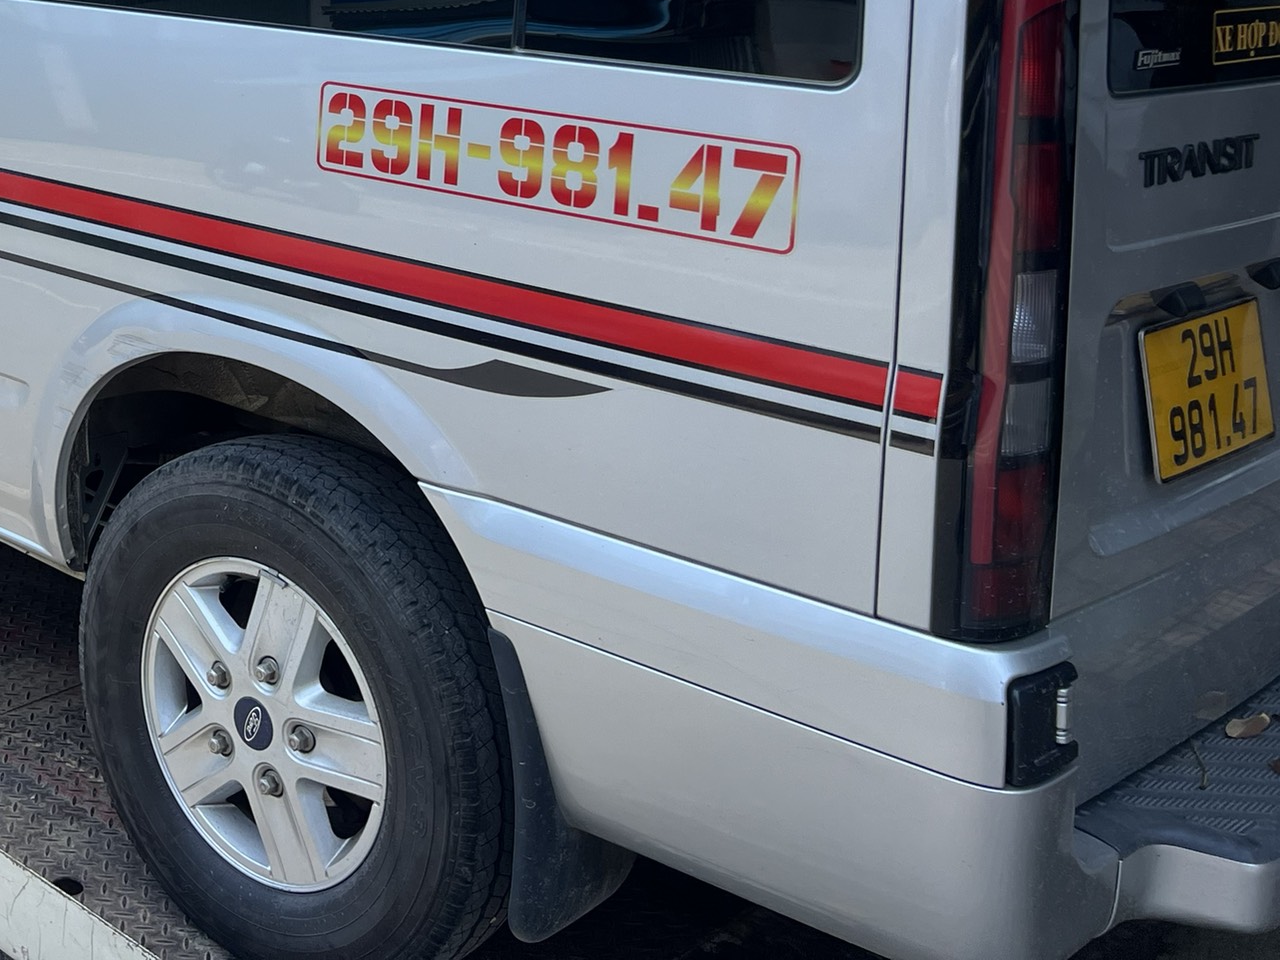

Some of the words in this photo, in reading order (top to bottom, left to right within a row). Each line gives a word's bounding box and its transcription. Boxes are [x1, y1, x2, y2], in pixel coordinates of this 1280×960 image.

[1216, 25, 1233, 53] XE
[1237, 19, 1266, 57] HỢP
[325, 91, 788, 239] 29H-981.47
[1139, 133, 1260, 188] TRANSIT
[1181, 316, 1235, 389] 29H
[1170, 376, 1258, 466] 981.47
